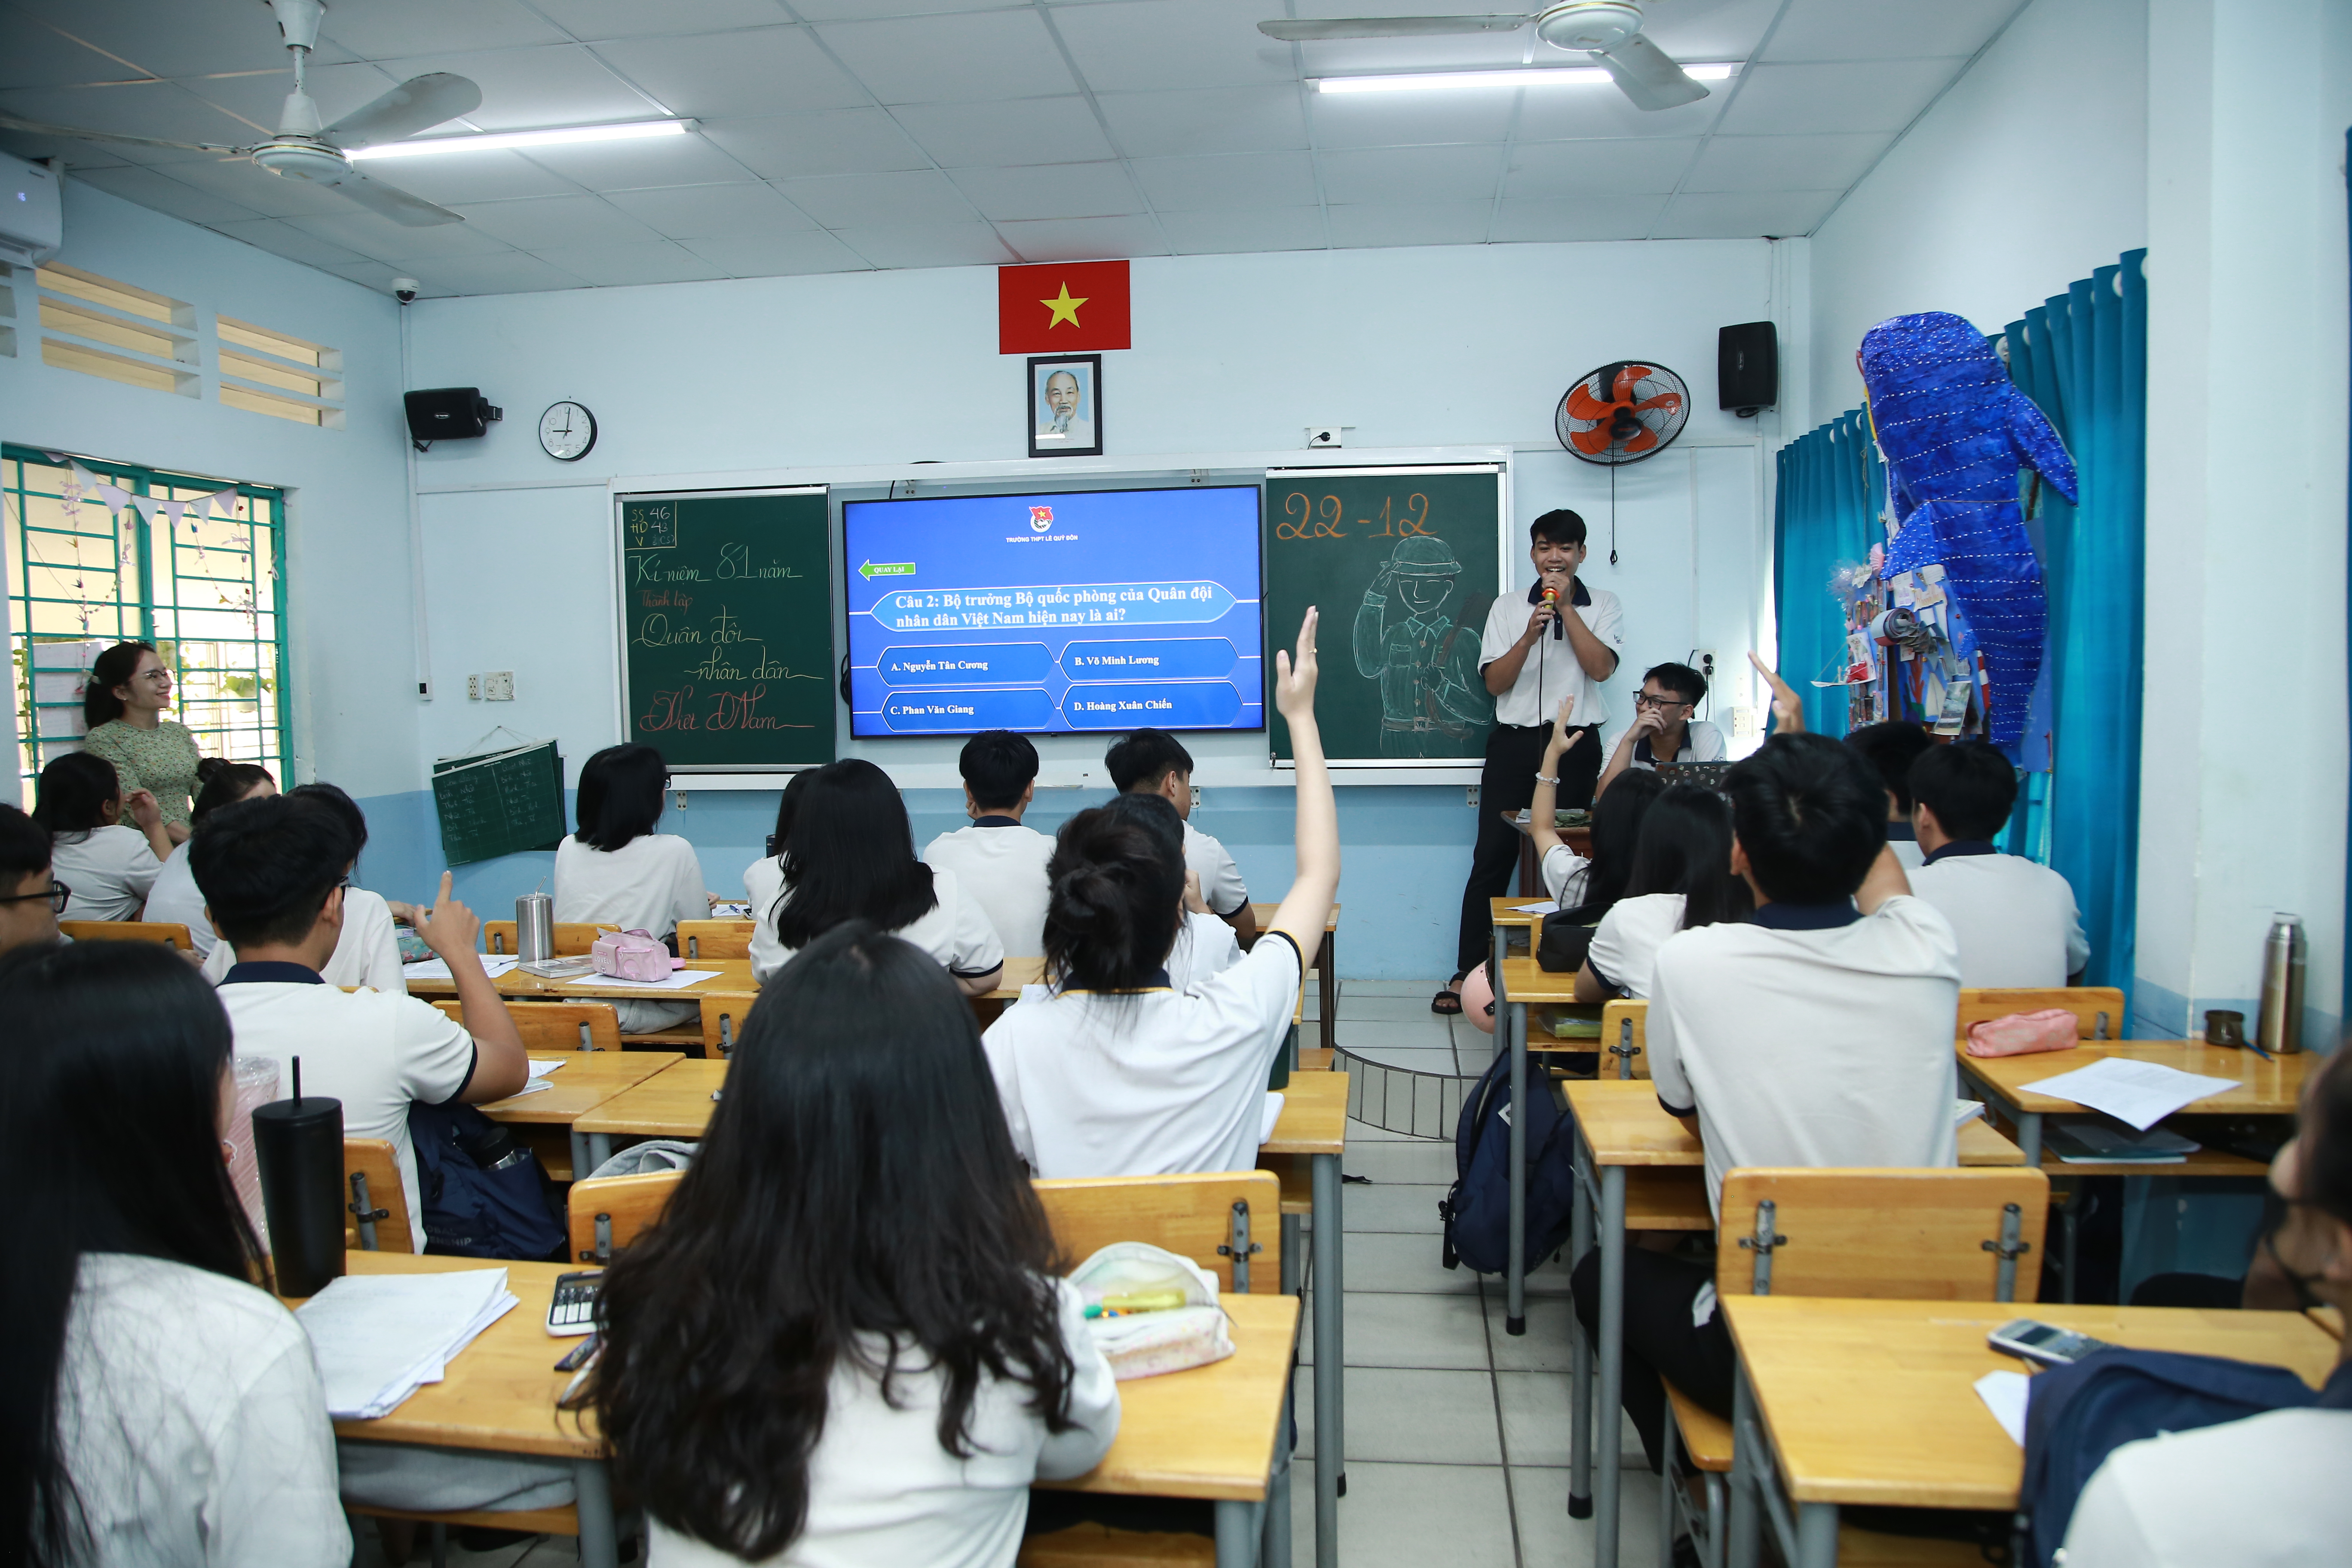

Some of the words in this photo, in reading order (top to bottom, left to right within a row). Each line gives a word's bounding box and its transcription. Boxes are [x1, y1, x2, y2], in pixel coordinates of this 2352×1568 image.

[545, 427, 551, 435] 9
[585, 426, 590, 434] 3
[548, 438, 554, 447] 8
[631, 509, 644, 522] SS
[649, 506, 670, 520] 46
[630, 521, 648, 533] HD
[651, 521, 668, 534] 43
[635, 536, 643, 546] V
[663, 565, 712, 585] niệm
[717, 542, 757, 579] 81
[756, 559, 803, 579] năm
[674, 590, 693, 616] lập
[896, 595, 922, 608] Câu
[926, 595, 939, 607] 2:
[943, 594, 961, 609] Bộ
[965, 593, 1012, 608] trưởng
[1015, 591, 1034, 607] Bộ
[1038, 587, 1070, 606] quốc
[1074, 589, 1116, 606] phòng
[1120, 588, 1144, 601] của
[1148, 587, 1186, 603] Quân
[1191, 586, 1212, 602] đội
[896, 614, 929, 627] nhân
[933, 613, 958, 626] dân
[961, 612, 989, 628] Việt
[992, 612, 1024, 625] Nam
[1028, 610, 1057, 626] hiện
[1061, 612, 1086, 625] nay
[1089, 609, 1102, 622] là
[1106, 608, 1126, 621] ai?
[631, 613, 707, 647] Quân
[684, 646, 747, 680] nhân
[752, 645, 824, 680] dân
[891, 663, 901, 671] A.
[903, 659, 936, 673] Nguyễn
[938, 661, 956, 670] Tân
[958, 661, 989, 671] Cương
[1075, 657, 1085, 666] B.
[1086, 656, 1099, 665] Võ
[1102, 656, 1126, 665] Minh
[1129, 655, 1160, 666] Lương
[640, 685, 701, 735] Việt
[706, 683, 815, 730] Nam
[890, 707, 900, 715] C.
[903, 706, 925, 714] Phan
[927, 705, 945, 714] Văn
[947, 704, 974, 715] Giang
[1074, 702, 1084, 710] D.
[1087, 701, 1117, 712] Hoàng
[1118, 701, 1143, 710] Xuân
[1145, 697, 1172, 709] Chiến
[595, 956, 611, 964] LOVELY
[426, 1224, 458, 1236] OBAL
[429, 1236, 472, 1246] ENSHIP
